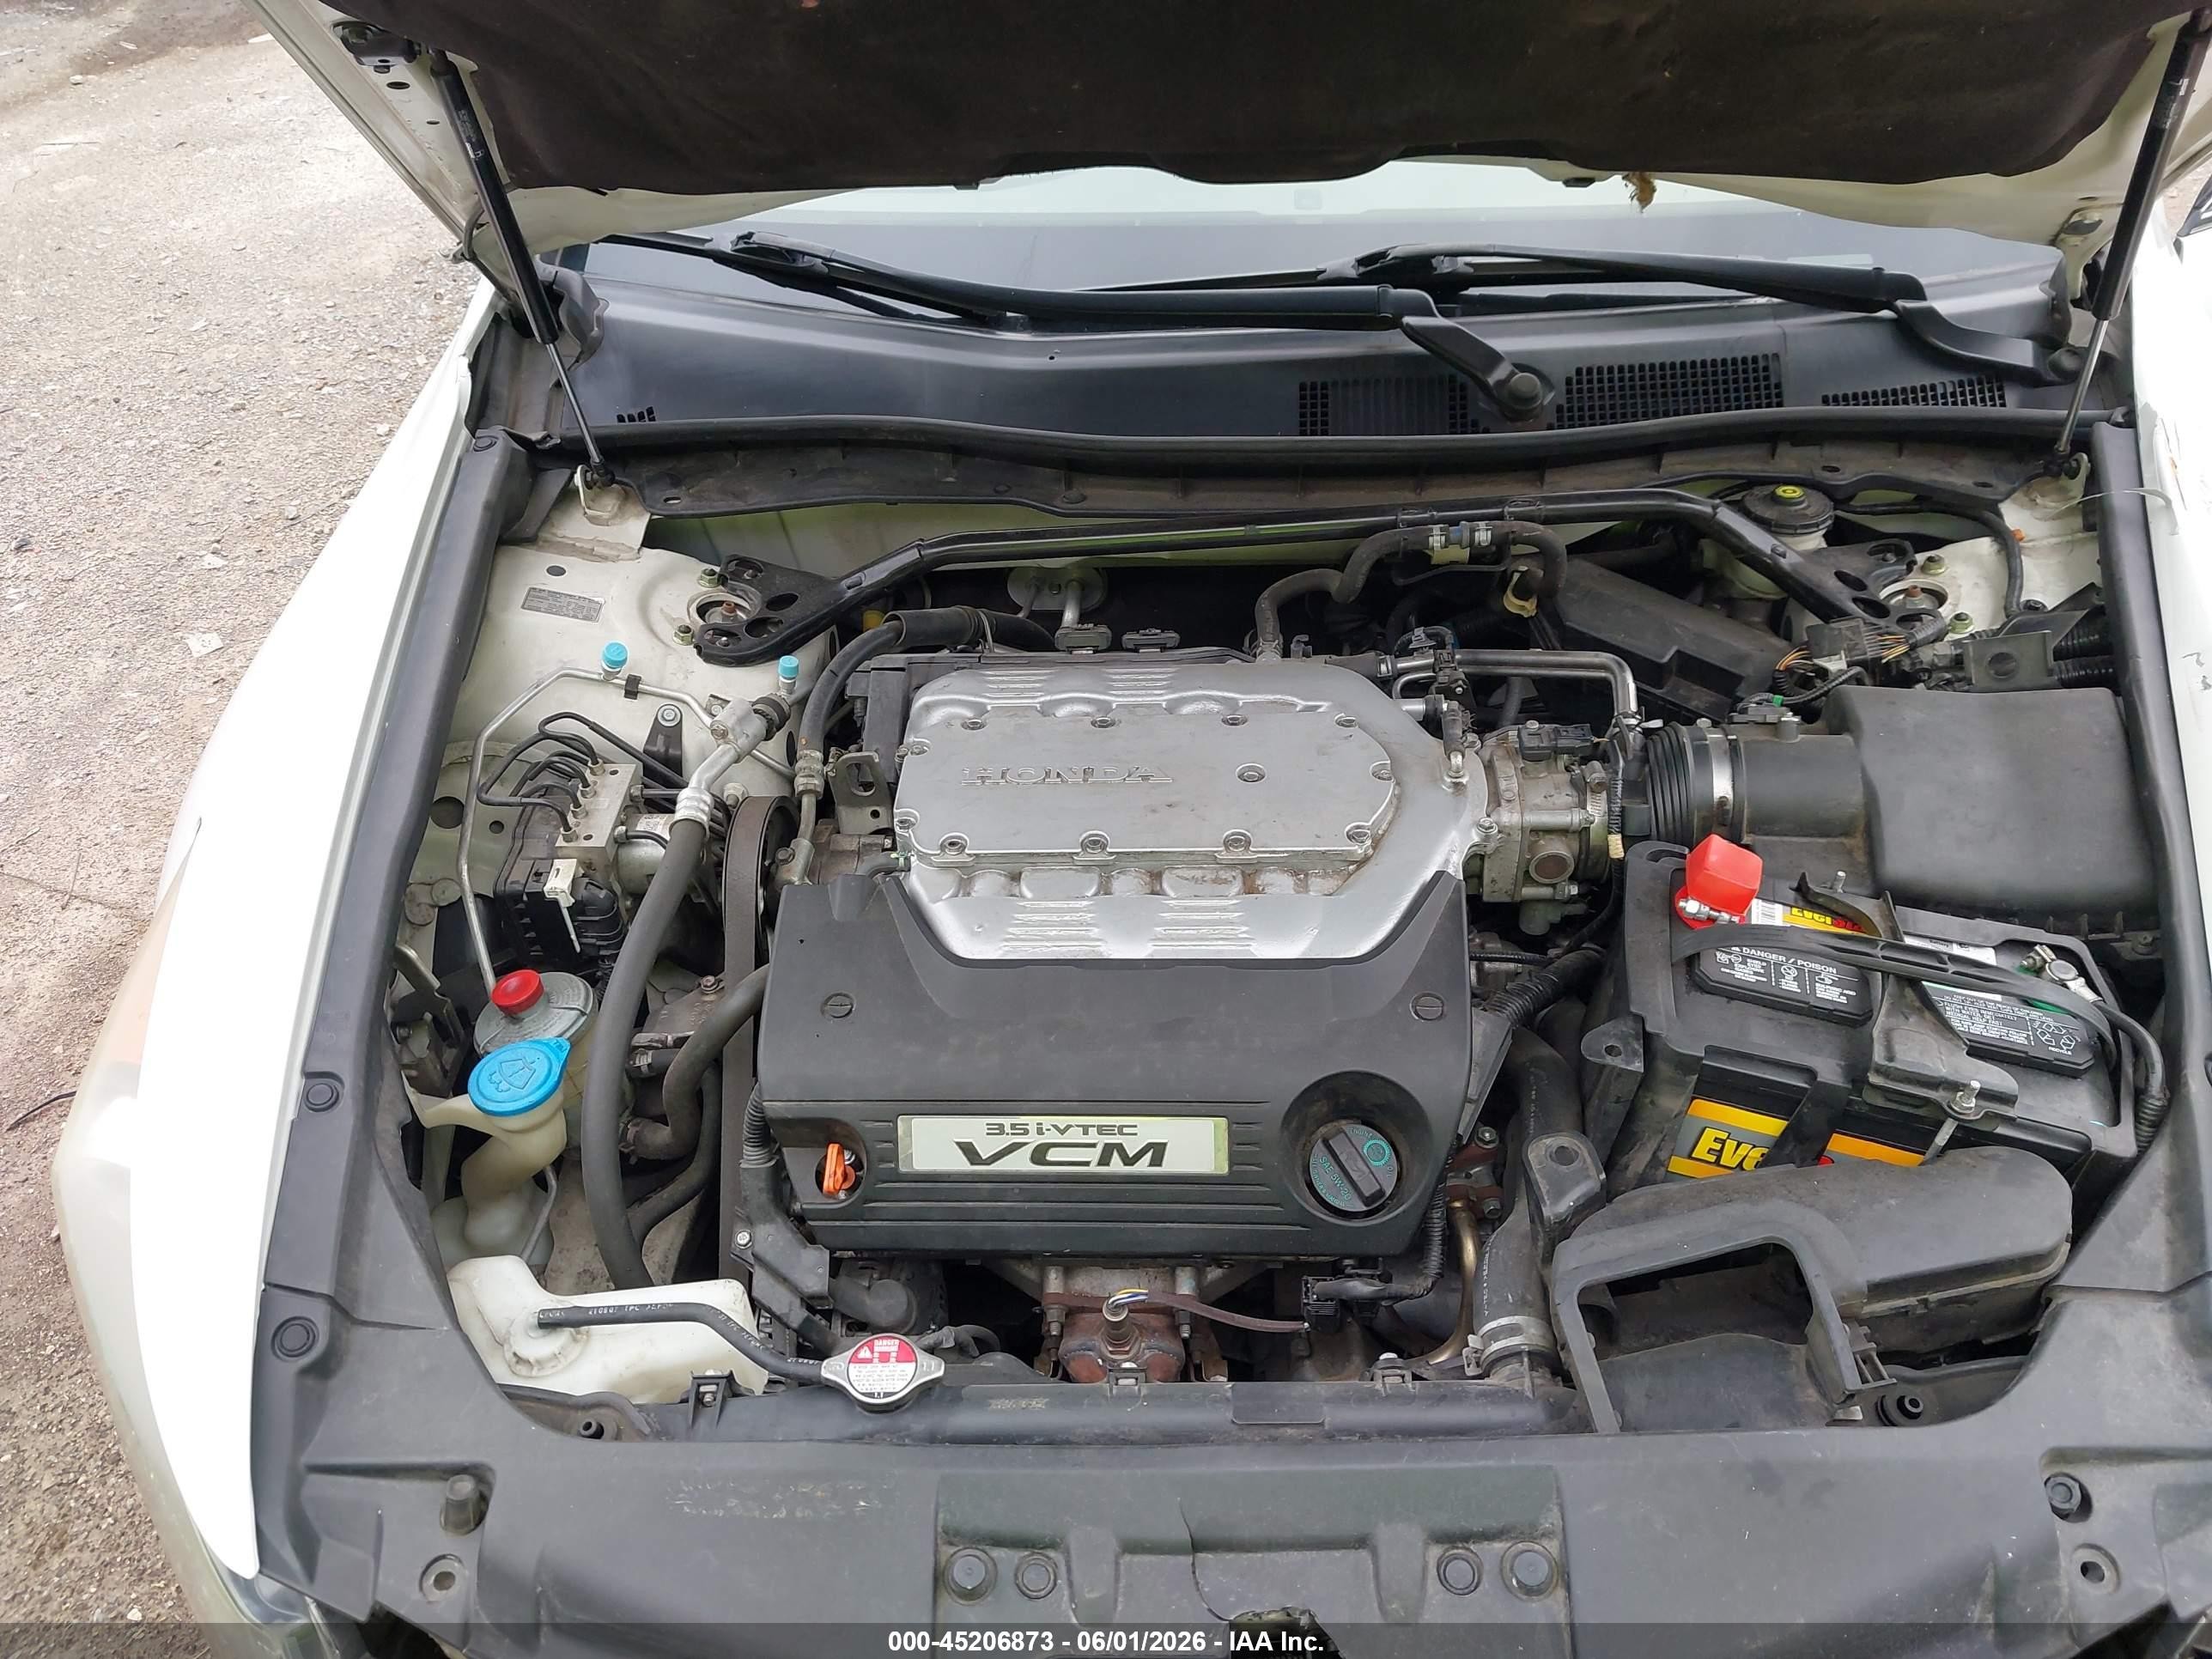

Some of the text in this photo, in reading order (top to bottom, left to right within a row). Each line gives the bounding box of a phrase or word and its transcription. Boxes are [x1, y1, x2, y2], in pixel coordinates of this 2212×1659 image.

[962, 766, 1173, 785] HONDA
[1742, 947, 1786, 963] DANGER
[1796, 959, 1837, 974] POISON
[986, 1122, 1138, 1136] 3.5 i-VTEC
[954, 1139, 1169, 1168] VCM
[1320, 1156, 1353, 1200] SAE 5W-20
[922, 1361, 935, 1372] 1.1
